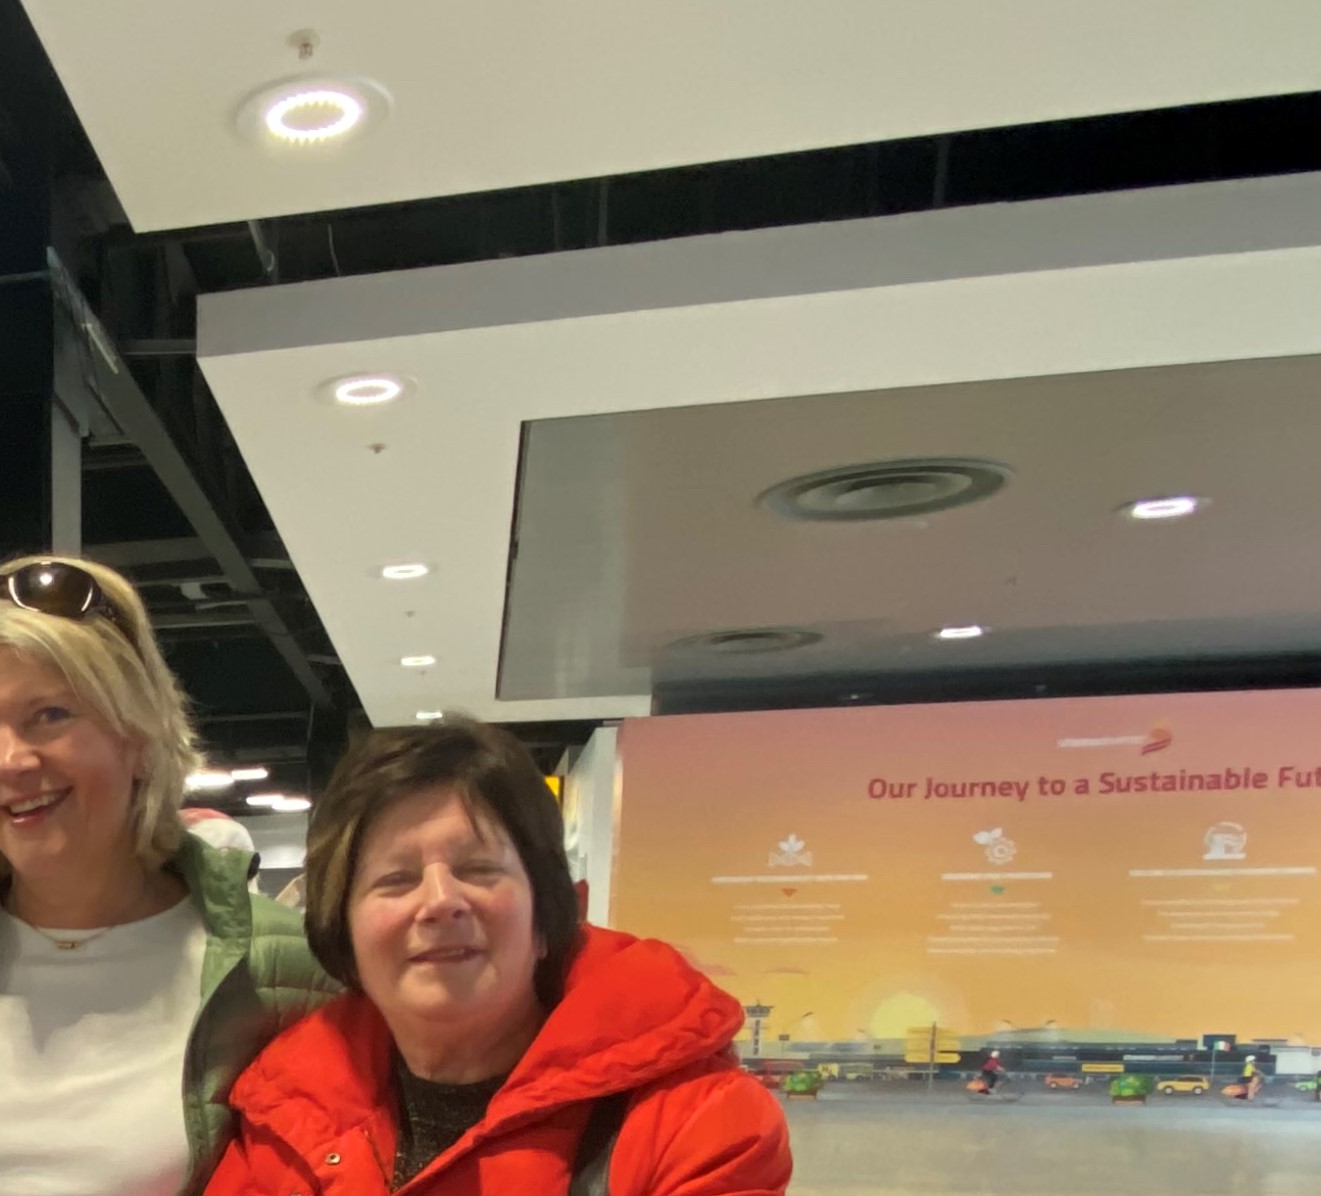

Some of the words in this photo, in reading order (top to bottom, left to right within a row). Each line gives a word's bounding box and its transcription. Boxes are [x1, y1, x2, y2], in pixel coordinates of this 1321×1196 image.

[868, 778, 917, 799] Our
[924, 776, 1029, 802] Journey
[1038, 776, 1066, 796] to
[1074, 777, 1090, 795] a
[1099, 767, 1269, 794] Sustainable
